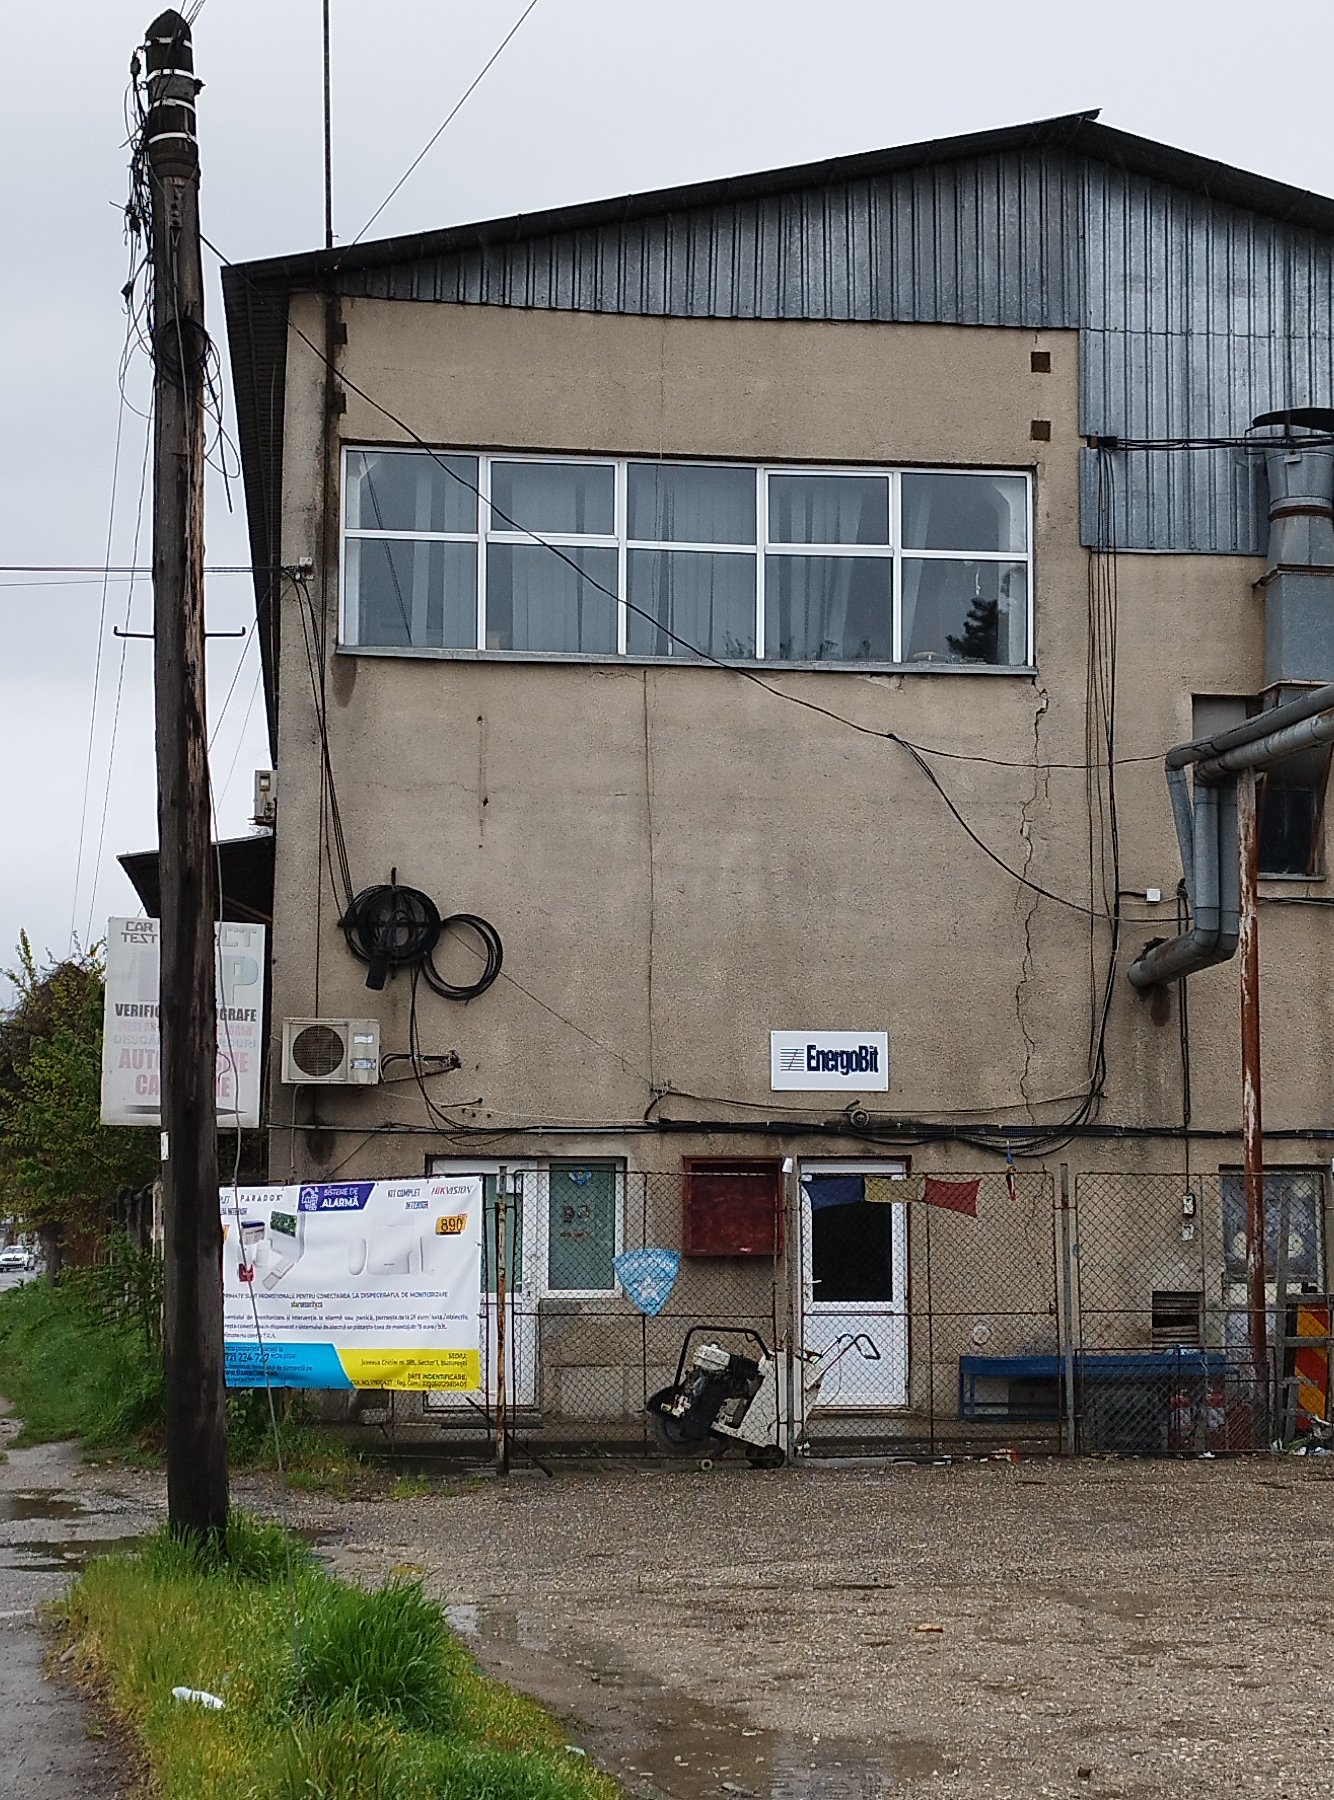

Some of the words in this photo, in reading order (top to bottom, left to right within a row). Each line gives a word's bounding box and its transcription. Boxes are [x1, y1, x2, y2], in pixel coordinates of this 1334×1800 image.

[125, 920, 154, 932] CAR
[120, 932, 158, 944] TEST
[806, 1044, 879, 1076] EnergoBit
[431, 1185, 473, 1195] HIKVISION
[240, 1194, 281, 1202] PARADOX
[321, 1195, 359, 1208] ALARMĂ
[440, 1218, 463, 1231] 890
